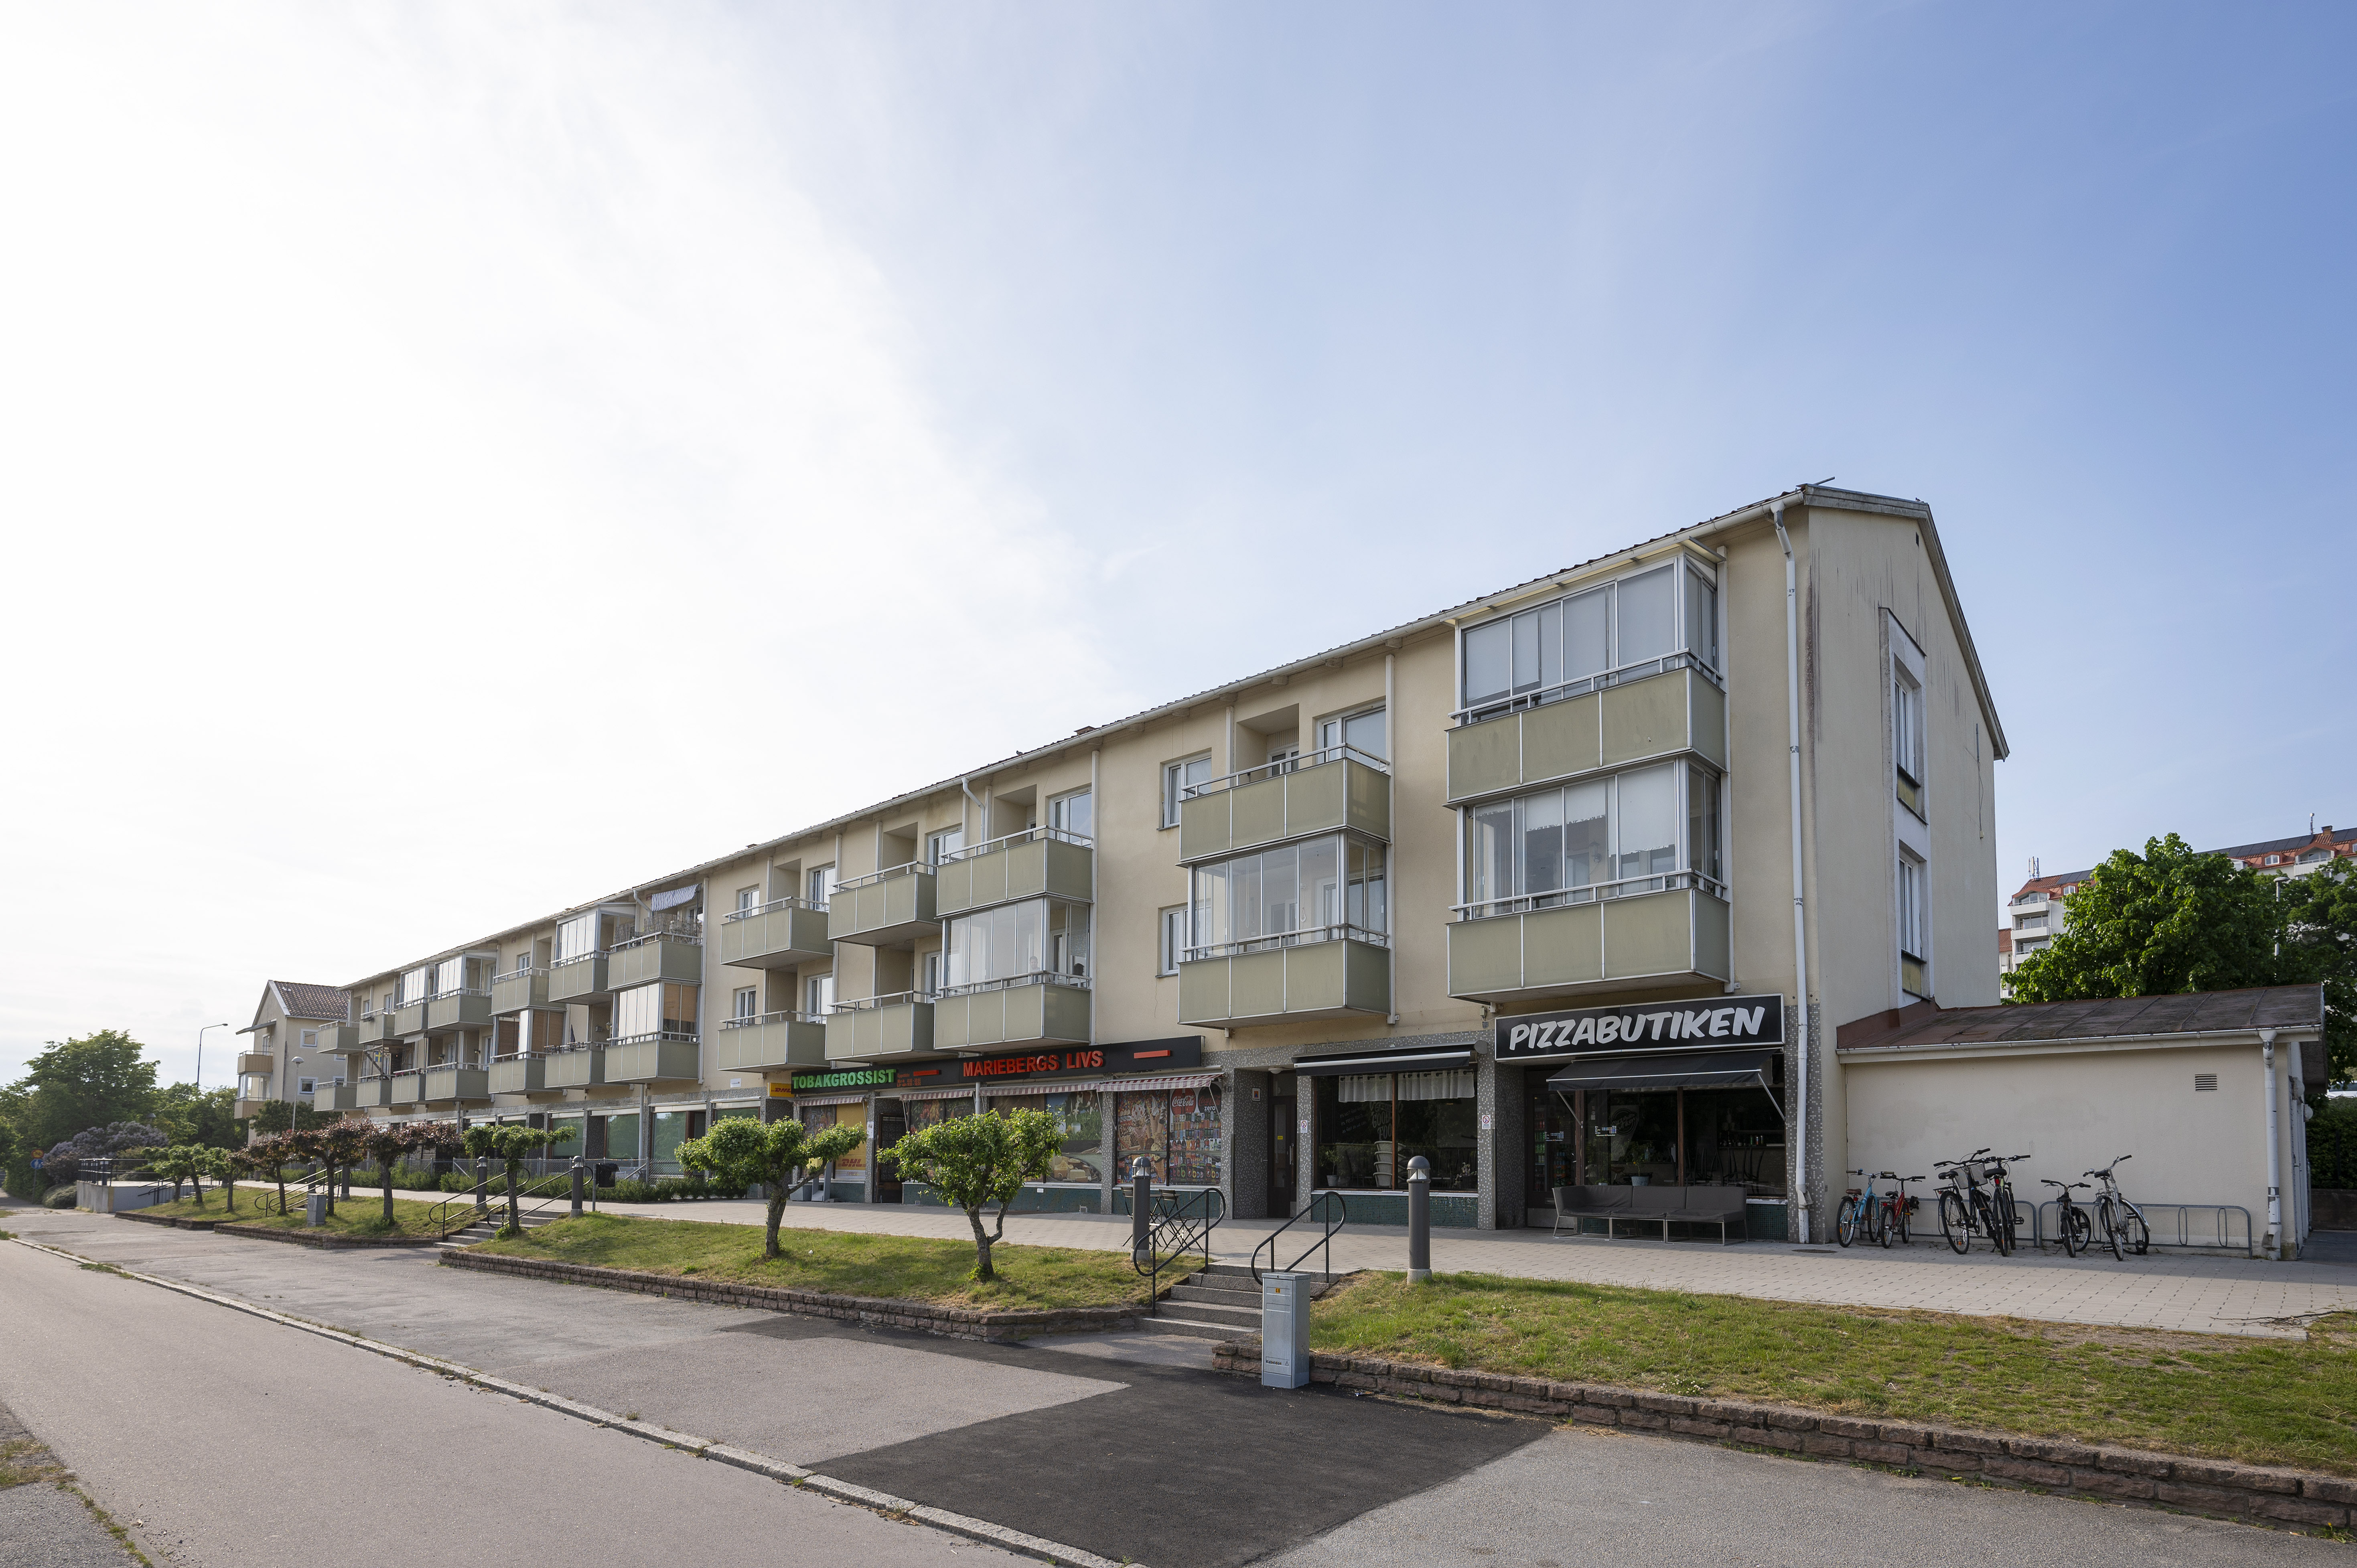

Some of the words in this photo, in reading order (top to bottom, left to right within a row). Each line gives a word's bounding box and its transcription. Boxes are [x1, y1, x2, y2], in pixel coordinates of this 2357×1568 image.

[1509, 1006, 1765, 1051] PIZZABUTIKEN
[963, 1055, 1059, 1077] MARIEBERGS
[1067, 1051, 1103, 1069] LIVS
[792, 1069, 896, 1089] TOBAKGROSSIST
[842, 1159, 862, 1167] DHL
